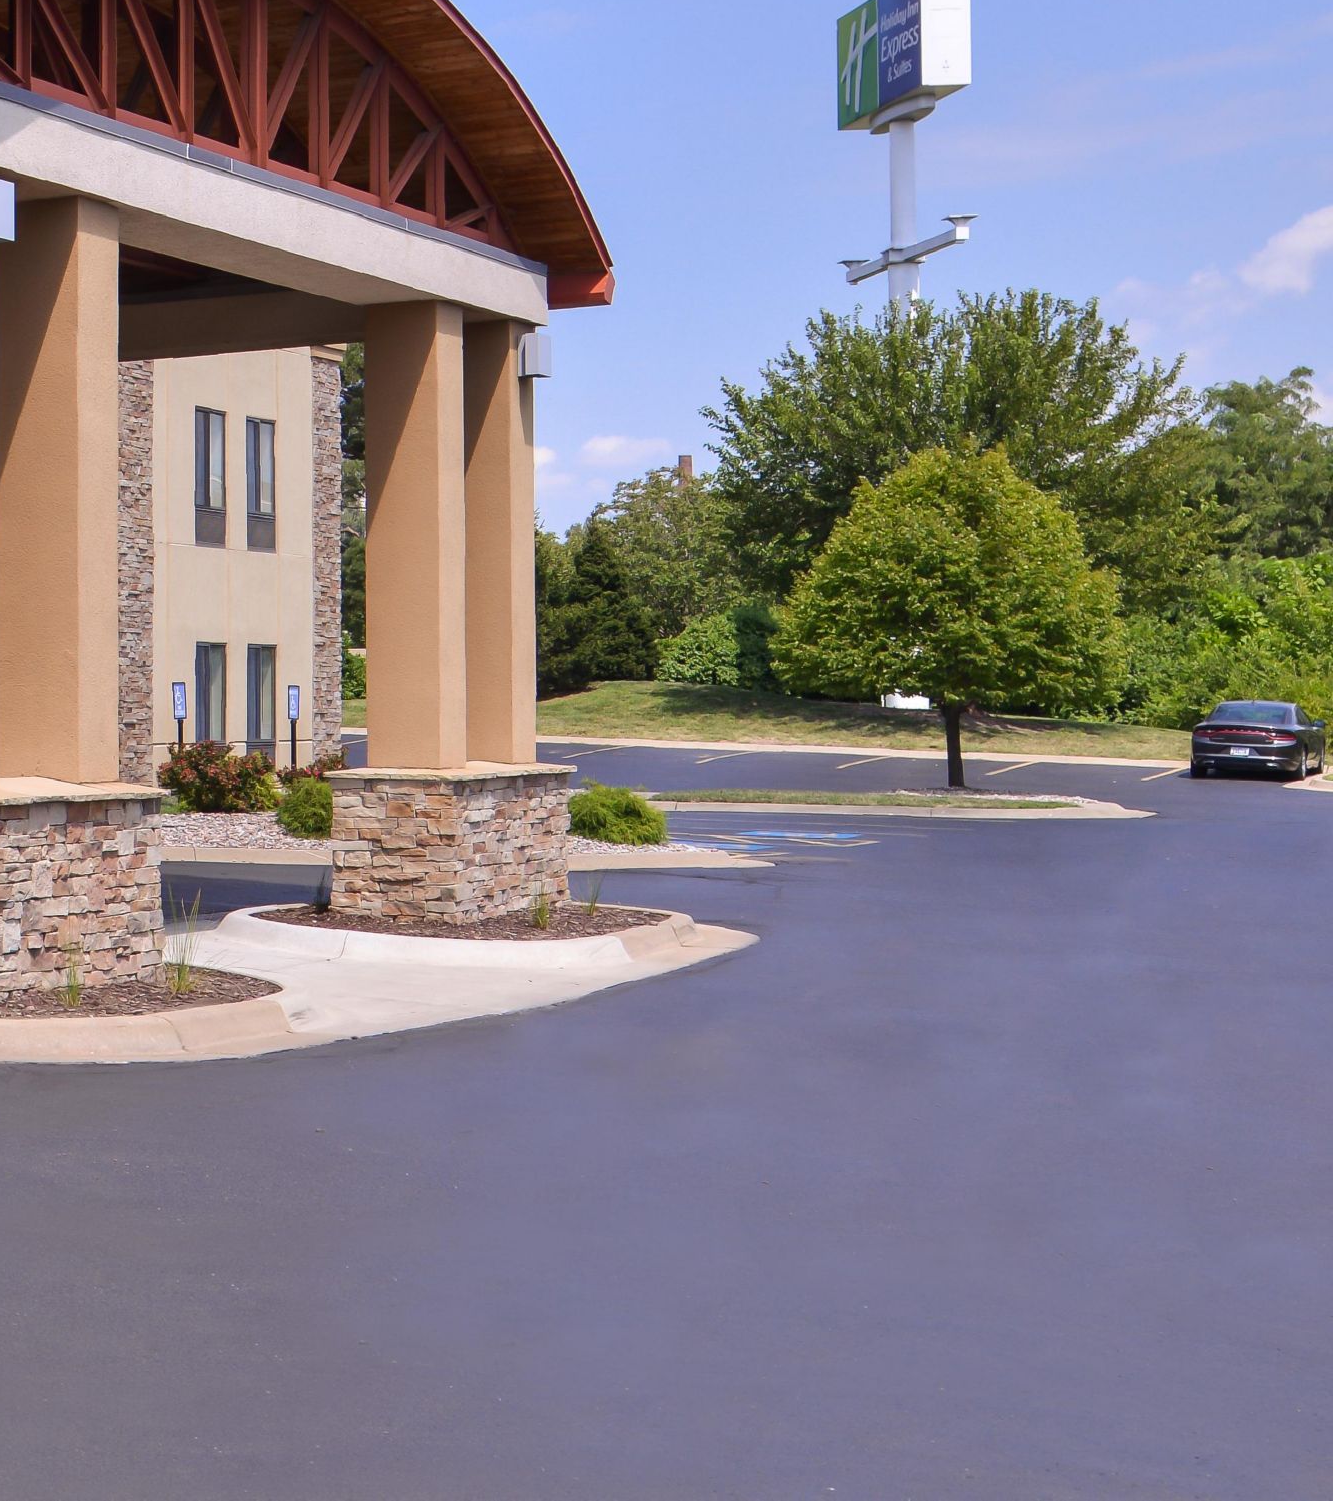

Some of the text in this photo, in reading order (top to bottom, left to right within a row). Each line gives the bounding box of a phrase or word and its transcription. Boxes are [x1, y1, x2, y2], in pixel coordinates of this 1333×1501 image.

[880, 0, 919, 33] Holiday Inn
[881, 25, 919, 63] Express
[887, 59, 912, 83] & Suites
